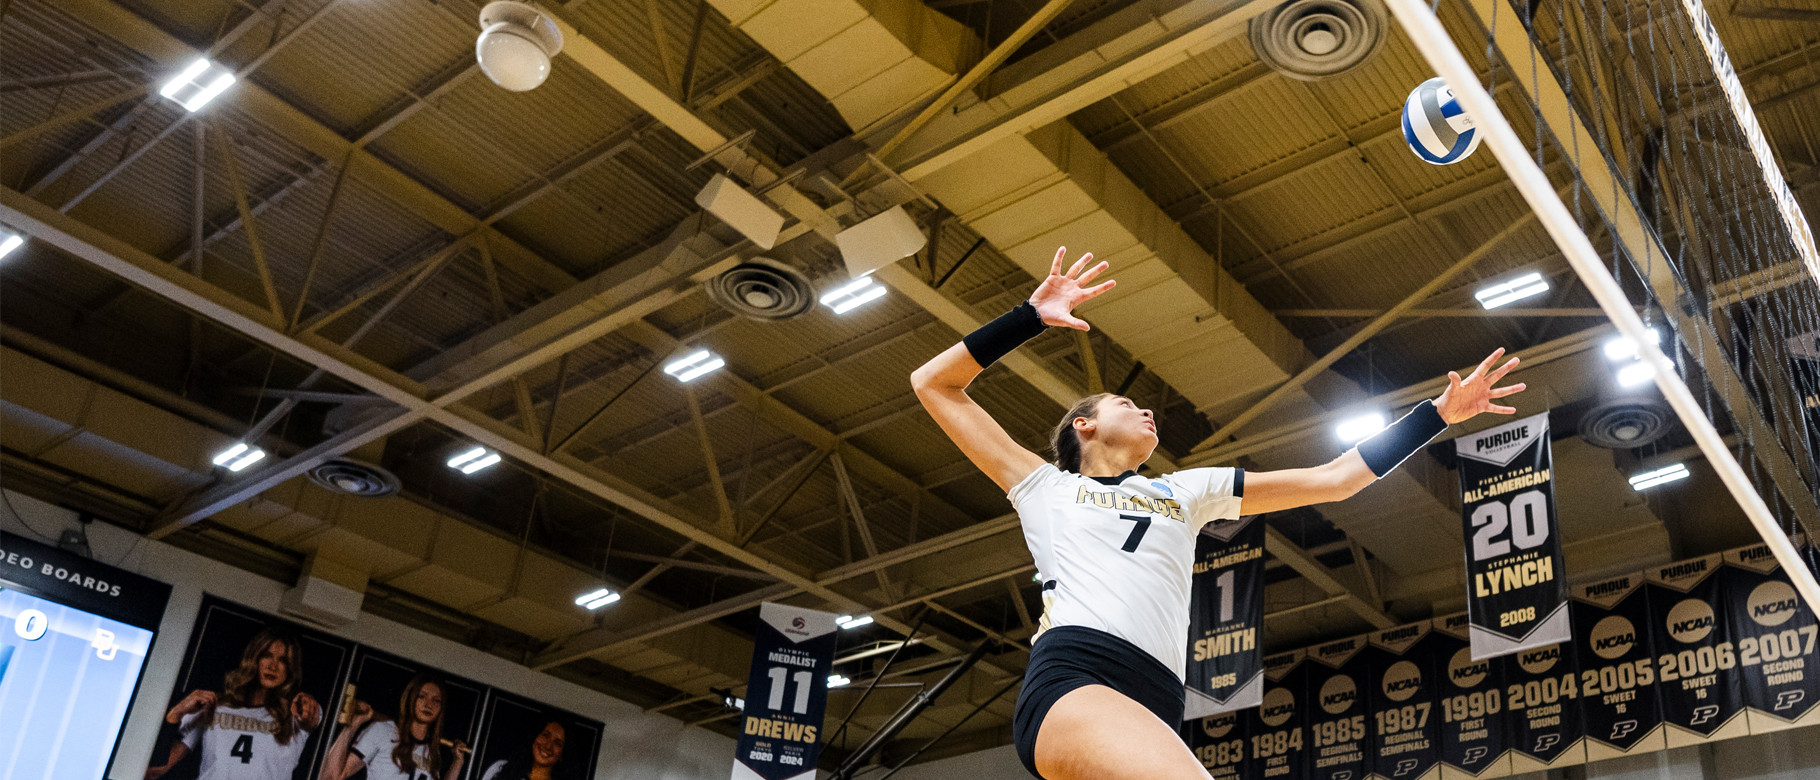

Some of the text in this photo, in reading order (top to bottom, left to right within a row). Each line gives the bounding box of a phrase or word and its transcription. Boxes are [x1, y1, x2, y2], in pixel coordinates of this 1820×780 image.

[1476, 425, 1529, 453] PURDUE
[1479, 466, 1533, 486] FIRST TEAM
[1464, 468, 1550, 504] ALL-AMERICAN
[1119, 513, 1152, 553] 7
[1471, 489, 1549, 562] 20
[1206, 543, 1249, 559] FIRST TEAM
[1193, 547, 1262, 574] ALL-AMERICAN
[1488, 551, 1539, 570] STEPHANIE
[1660, 559, 1707, 580] PURDUE
[41, 563, 121, 597] BOARDS
[1475, 555, 1554, 598] LYNCH
[1216, 570, 1234, 622] 1
[1585, 577, 1630, 597] PURDUE
[1500, 606, 1536, 628] 2008
[1754, 598, 1797, 618] NCAA
[1205, 622, 1245, 636] MARIANNE
[1445, 614, 1469, 628] PUR
[1673, 615, 1714, 635] NCAA
[1381, 626, 1419, 643] PURDUE
[1596, 632, 1635, 650] NCAA
[778, 648, 810, 657] OLYMPIC
[1193, 627, 1256, 662] SMITH
[1319, 640, 1356, 657] PURDUE
[1739, 623, 1819, 667] 2007
[768, 652, 817, 668] MEDALIST
[1522, 648, 1560, 665] NCAA
[1658, 641, 1736, 682] 2006
[1453, 663, 1489, 680] NCAA
[1762, 657, 1805, 675] SECOND
[1211, 673, 1236, 689] 1985
[1386, 677, 1420, 694] NCAA
[1581, 657, 1655, 697] 2005
[1682, 674, 1717, 690] SWEET
[1767, 669, 1804, 687] ROUND
[768, 667, 813, 714] 11
[1323, 690, 1356, 707] NCAA
[1507, 672, 1578, 711] 2004
[1603, 689, 1636, 705] SWEET
[1695, 688, 1708, 699] 16
[1263, 703, 1295, 719] NCAA
[1442, 688, 1501, 723] 1990
[1526, 703, 1562, 719] SECOND
[1615, 703, 1627, 715] 16
[771, 714, 796, 722] ANNIE
[1206, 715, 1236, 730] NCAA
[1375, 701, 1432, 736] 1987
[1460, 718, 1485, 731] FIRST
[1530, 715, 1560, 730] ROUND
[744, 716, 817, 744] DREWS
[1312, 715, 1366, 748] 1985
[1384, 730, 1424, 745] REGIONAL
[1459, 729, 1488, 743] ROUND
[230, 734, 254, 764] 4
[1251, 727, 1303, 759] 1984
[1320, 742, 1359, 757] REGIONAL
[1380, 739, 1430, 757] SEMIFINALS
[749, 751, 773, 762] 2020
[779, 754, 803, 766] 2024
[1195, 739, 1243, 768] 1983
[1266, 755, 1288, 767] FIRST
[1316, 751, 1363, 768] SEMIFINALS
[1264, 765, 1290, 777] ROUND
